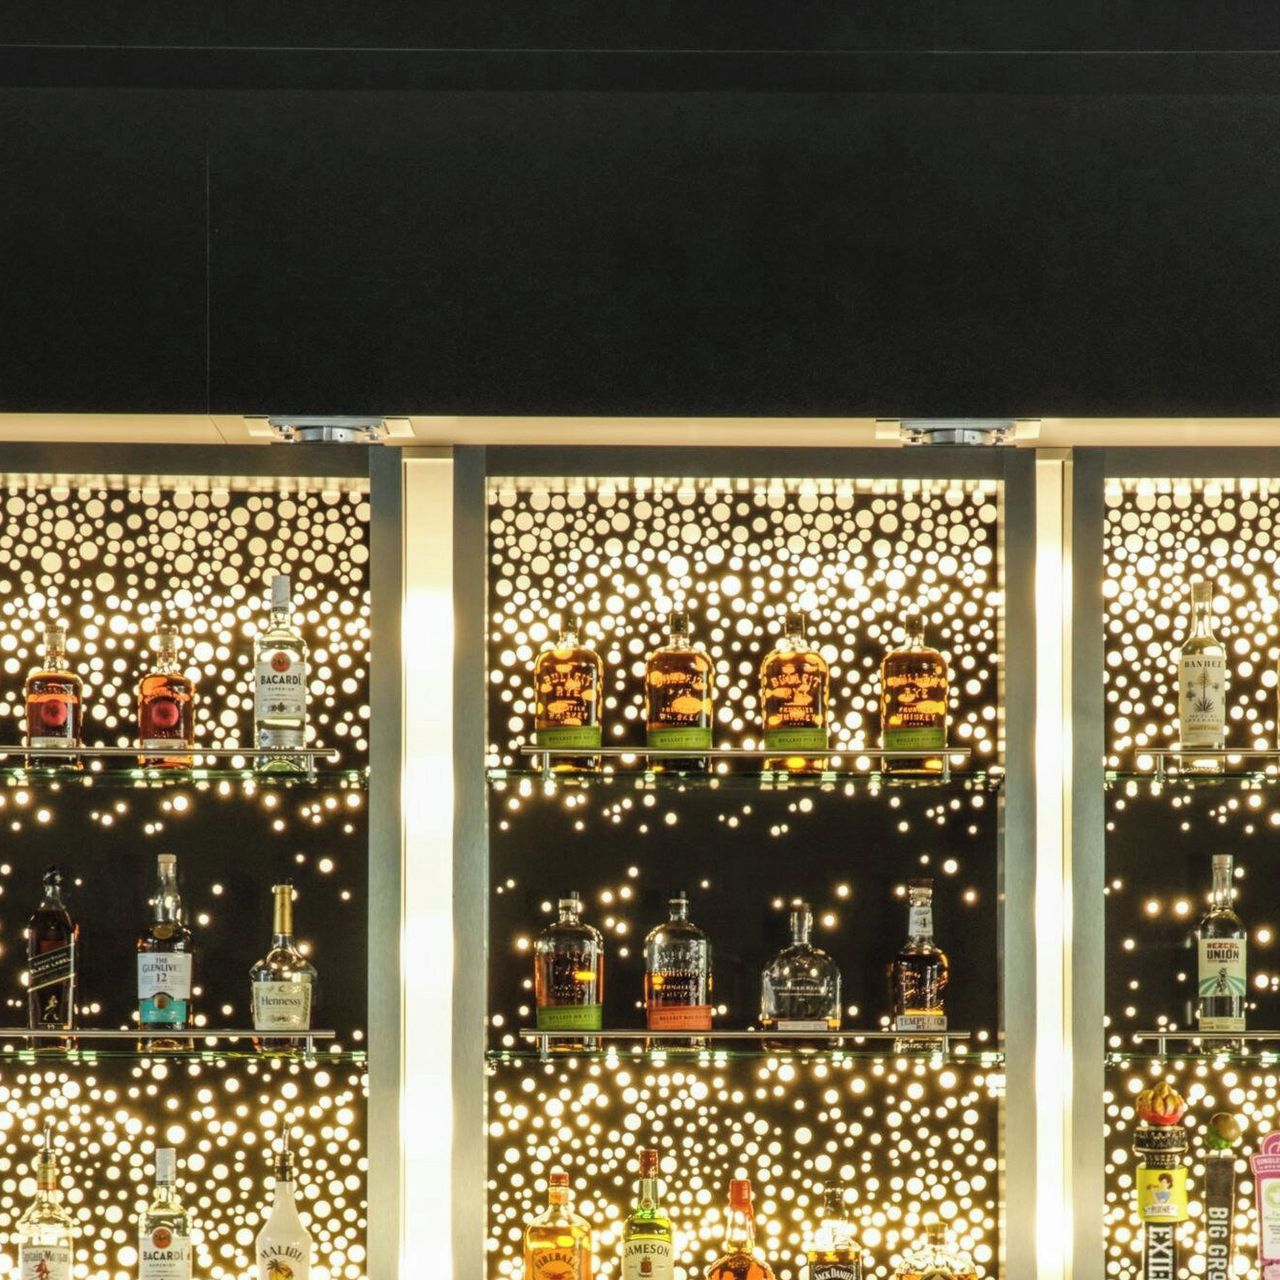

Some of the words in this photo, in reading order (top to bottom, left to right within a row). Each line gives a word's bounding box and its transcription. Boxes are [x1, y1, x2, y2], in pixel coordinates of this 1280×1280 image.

[556, 687, 581, 698] RYE
[156, 972, 167, 983] 12
[261, 995, 301, 1007] Hennessy
[1208, 1207, 1229, 1239] BIG
[624, 1243, 670, 1258] JAMESON
